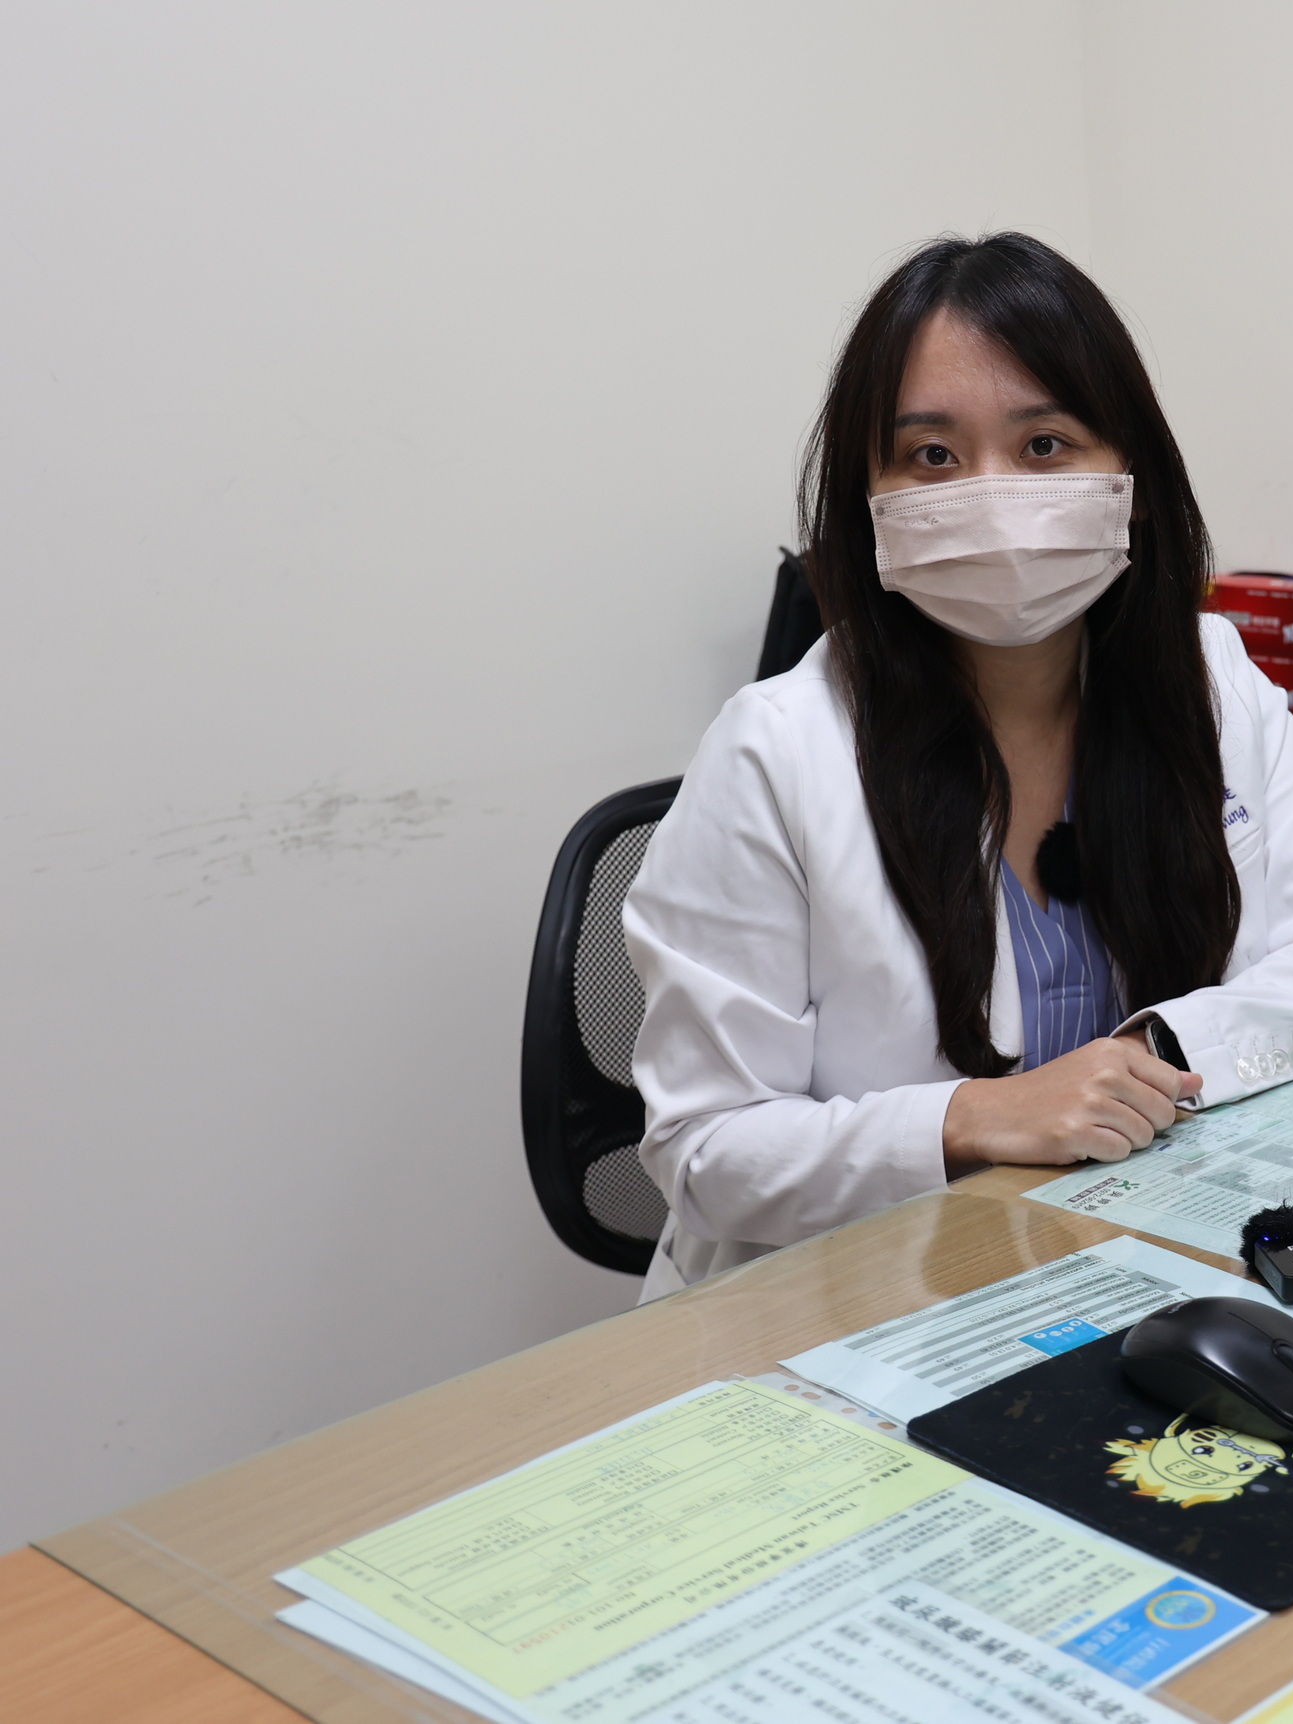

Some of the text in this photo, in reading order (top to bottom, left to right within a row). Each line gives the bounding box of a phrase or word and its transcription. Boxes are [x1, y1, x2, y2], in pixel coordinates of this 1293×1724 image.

[769, 1519, 823, 1545] Taiwan
[718, 1540, 777, 1570] Medical
[670, 1565, 726, 1593] Service
[588, 1588, 679, 1633] Corporation
